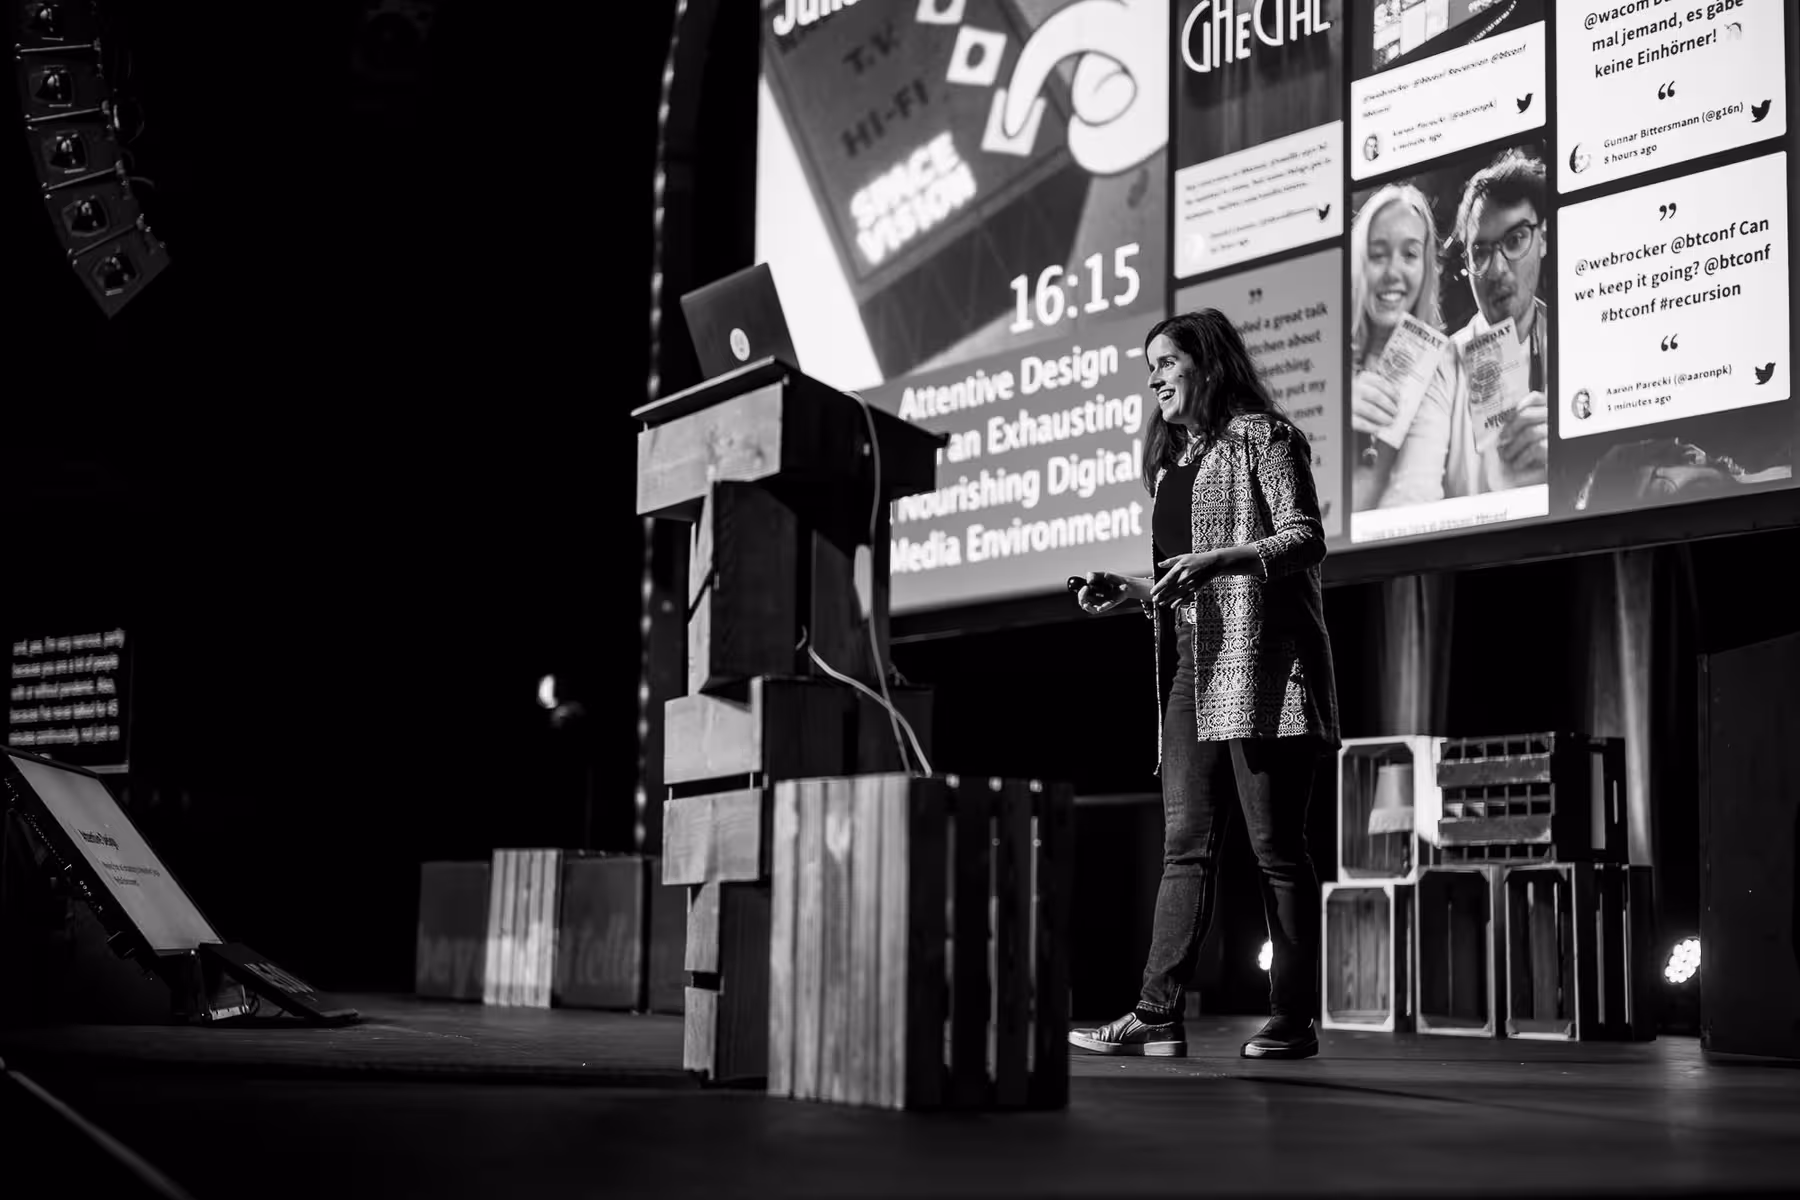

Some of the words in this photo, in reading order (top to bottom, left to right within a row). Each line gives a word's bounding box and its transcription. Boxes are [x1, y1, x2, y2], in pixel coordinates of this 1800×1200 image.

[1584, 0, 1649, 30] @wacom
[1592, 31, 1619, 52] mal
[1621, 12, 1683, 47] jemand,
[1686, 8, 1703, 22] es
[1707, 0, 1744, 21] gäbe
[1595, 57, 1633, 78] keine
[1638, 29, 1717, 66] Einhörner!
[841, 79, 929, 157] HI-FI
[1604, 132, 1638, 148] Gunnar
[1640, 115, 1700, 139] Bittersmann
[1702, 102, 1744, 123] (@g16n)
[1611, 149, 1637, 164] hours
[1640, 143, 1657, 157] ago
[1574, 287, 1594, 301] we
[1599, 278, 1632, 297] keep
[1637, 274, 1647, 288] it
[1651, 261, 1700, 288] going?
[1704, 244, 1771, 276] @btconf
[1575, 242, 1667, 276] @webrocker
[1671, 223, 1736, 254] @btconf
[1739, 219, 1770, 235] Can
[1009, 242, 1140, 334] 16:15
[1601, 299, 1657, 323] #btconf
[1660, 283, 1741, 310] #recursion
[1465, 325, 1512, 352] MONDAY
[898, 369, 1014, 421] Attentive
[1021, 345, 1118, 394] Design
[1606, 384, 1634, 396] Aaron
[1636, 376, 1671, 390] Parecki
[1674, 364, 1732, 385] (@aaronpk)
[1614, 398, 1652, 411] minutes
[1655, 394, 1671, 407] ago
[946, 429, 981, 463] an
[988, 393, 1142, 454] Exhausting
[1048, 439, 1142, 498] Digital
[967, 501, 1143, 562] Environment
